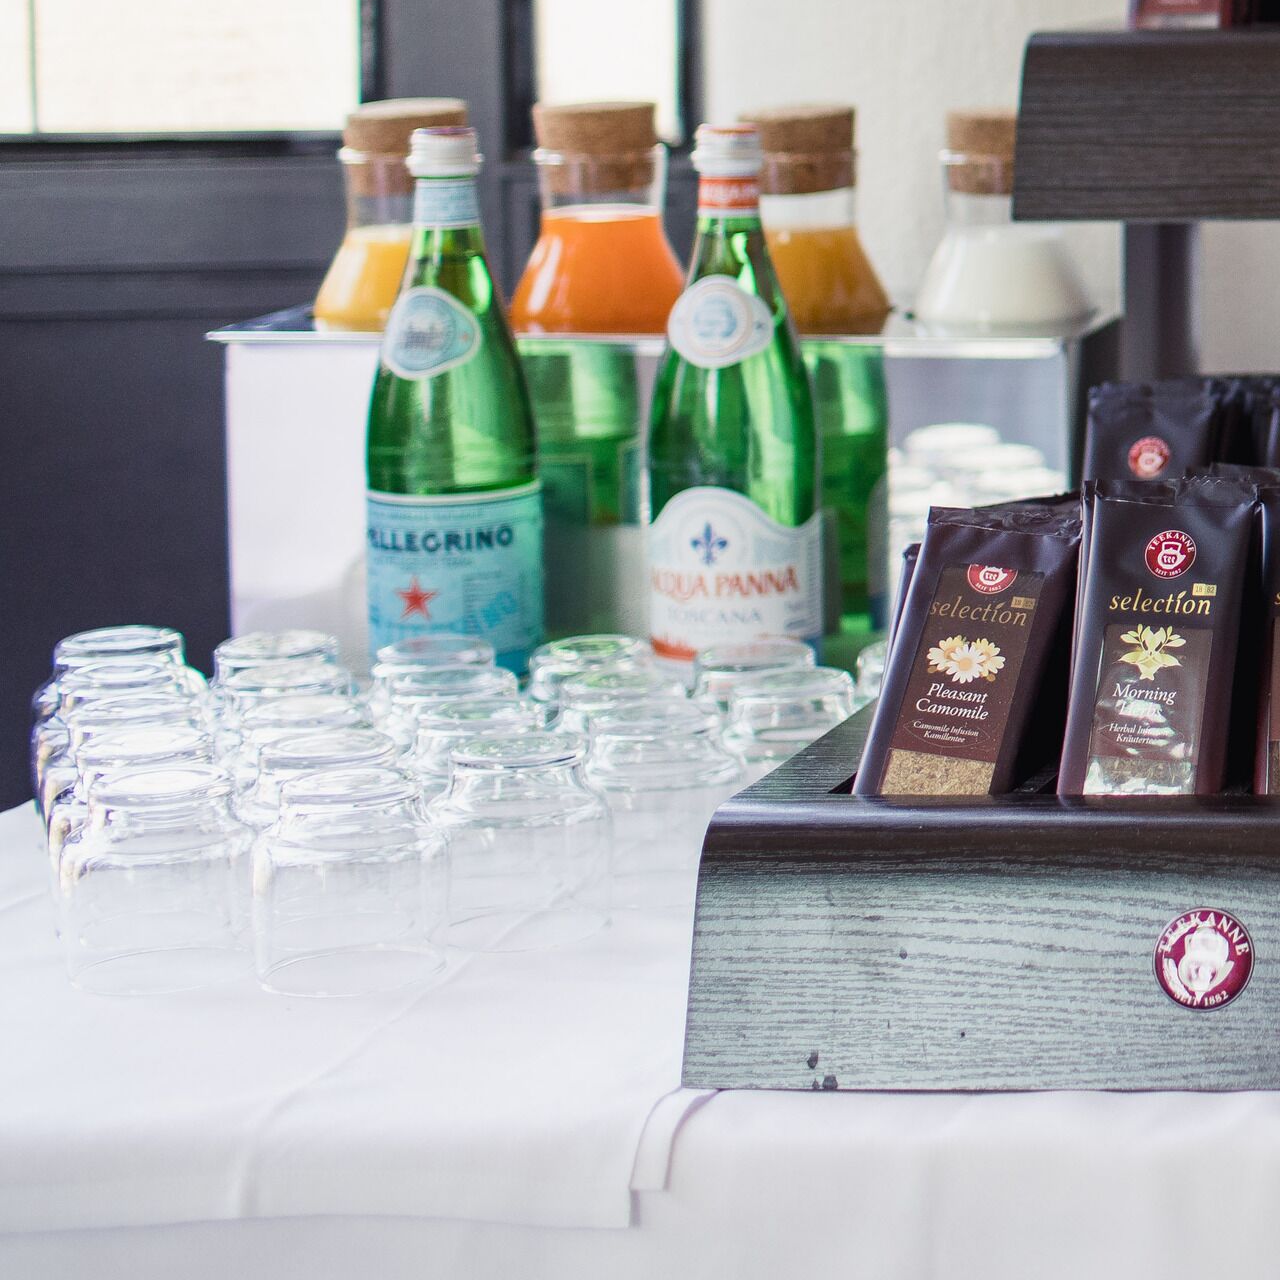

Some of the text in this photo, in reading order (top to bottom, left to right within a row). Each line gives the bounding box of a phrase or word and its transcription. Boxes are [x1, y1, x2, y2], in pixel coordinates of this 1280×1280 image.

[1149, 532, 1194, 553] TEEKANNE
[715, 566, 798, 599] PANNA
[930, 596, 1028, 627] selection
[1109, 588, 1211, 615] selection
[927, 683, 988, 704] Pleasant
[1112, 683, 1177, 705] Morning
[916, 698, 989, 720] Camomile
[913, 720, 979, 737] Camomile Infusion
[924, 731, 966, 743] Kamillentee
[1109, 723, 1136, 733] Herbal
[1158, 911, 1250, 956] TEEKANNE
[1204, 990, 1229, 1006] 1882
